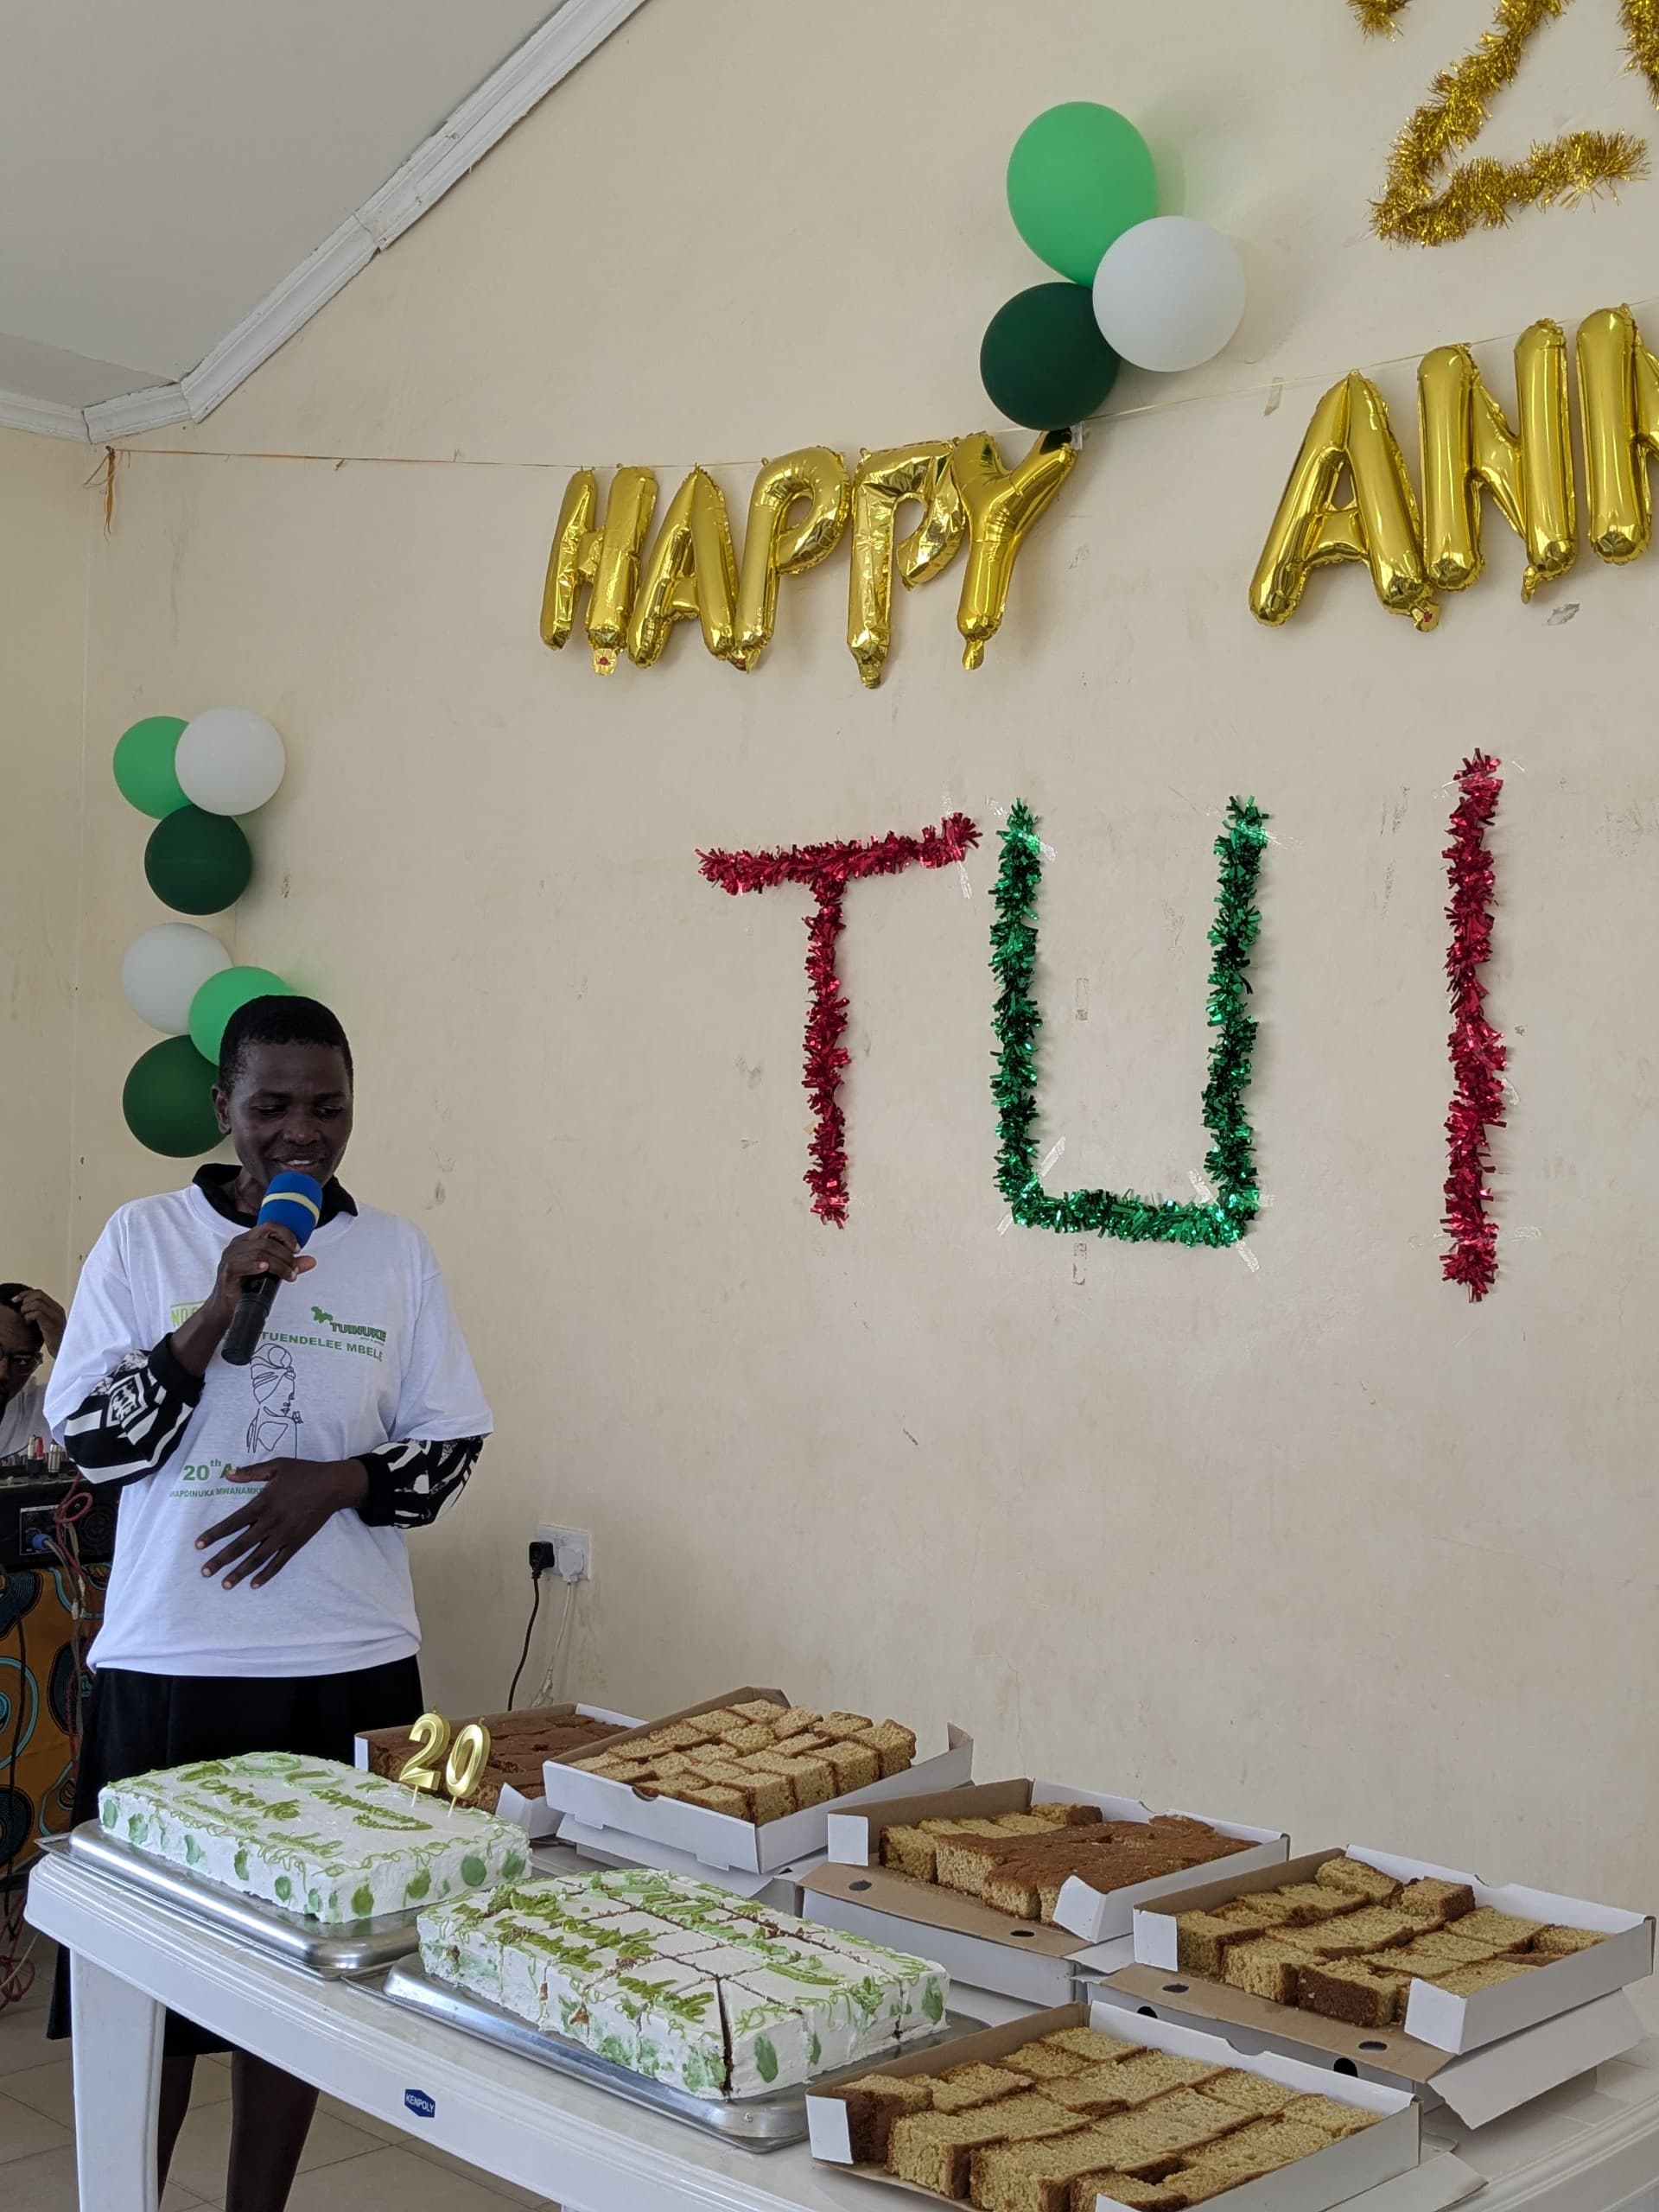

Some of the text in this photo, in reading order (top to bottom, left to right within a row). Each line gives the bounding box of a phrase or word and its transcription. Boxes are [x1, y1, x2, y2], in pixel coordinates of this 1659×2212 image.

[540, 429, 1078, 689] HAPPY
[262, 1332, 343, 1351] TUENDELEE
[330, 1322, 386, 1342] TUINUKE
[399, 1712, 491, 1798] 20
